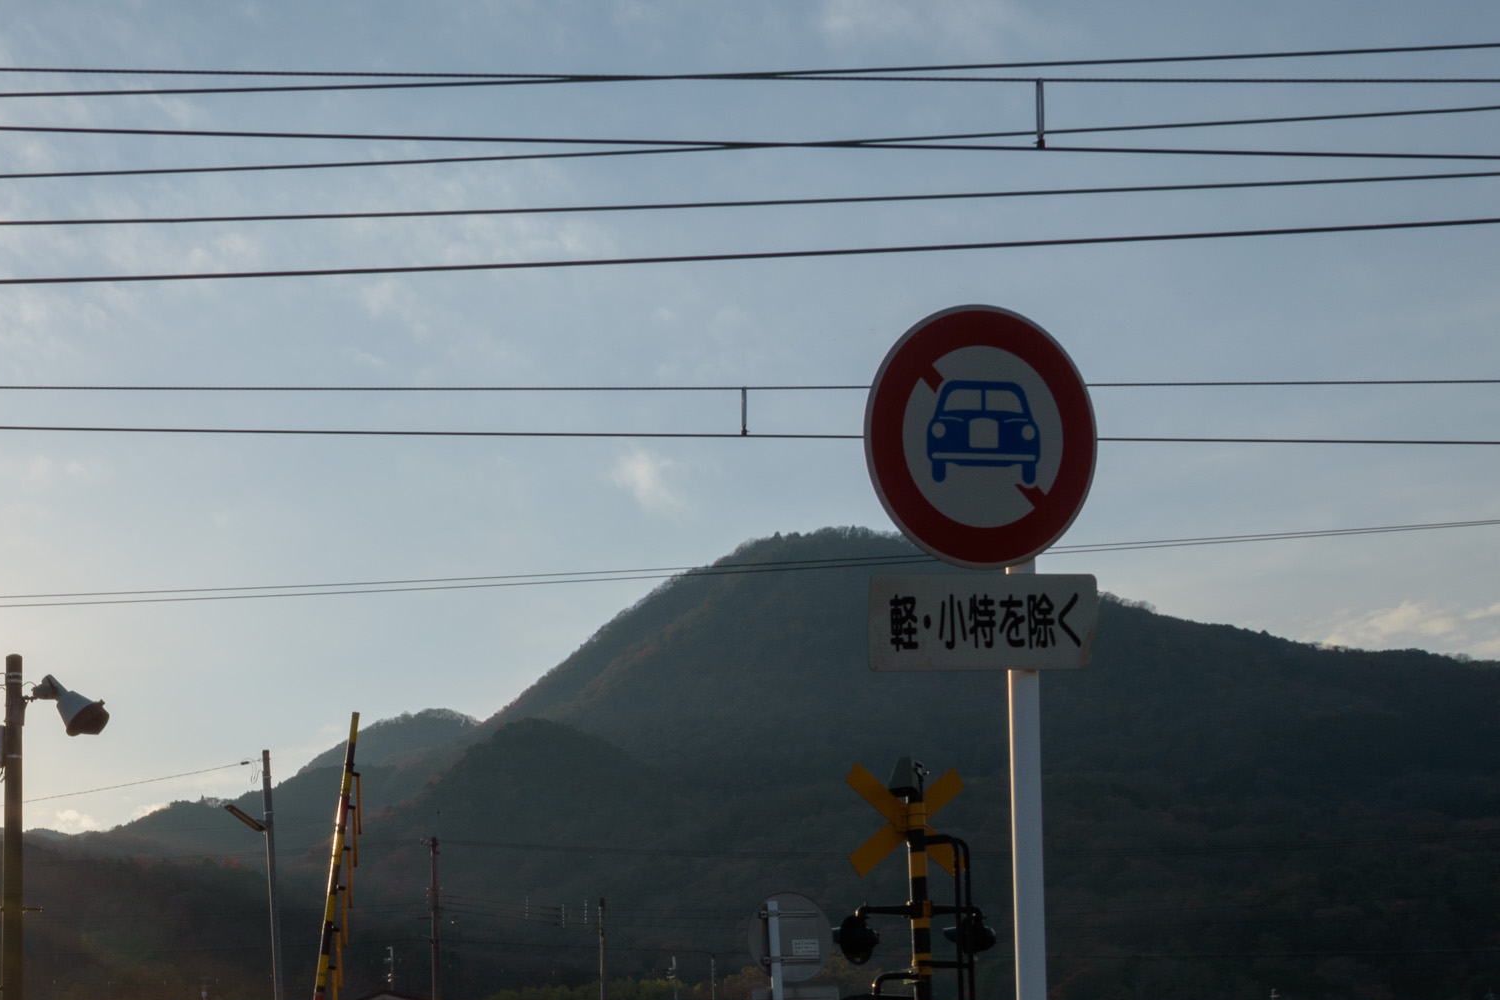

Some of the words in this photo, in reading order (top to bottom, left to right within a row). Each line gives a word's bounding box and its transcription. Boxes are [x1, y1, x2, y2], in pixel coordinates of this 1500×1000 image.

[889, 592, 1082, 652] 軽・小特を除く
